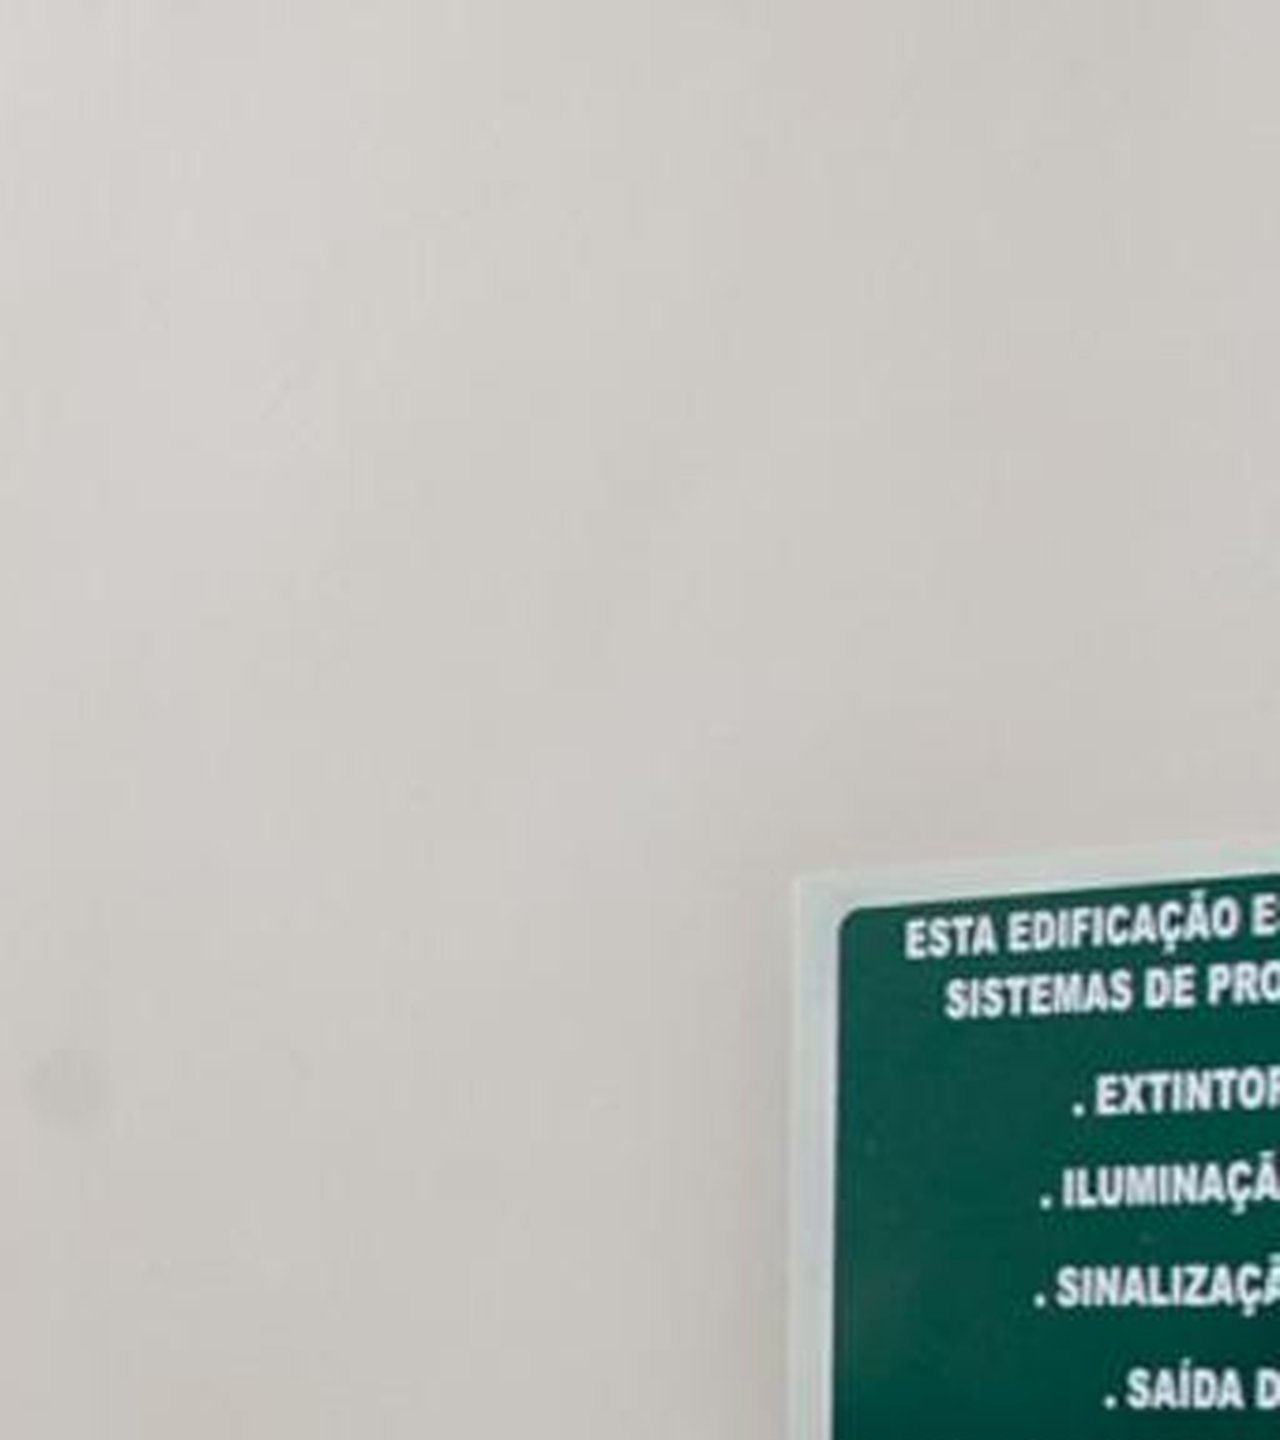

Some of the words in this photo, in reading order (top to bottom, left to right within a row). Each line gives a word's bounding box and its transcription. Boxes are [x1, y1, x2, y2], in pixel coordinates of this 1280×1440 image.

[904, 913, 998, 960] ESTA
[1007, 888, 1242, 954] EDIFICAÇÃO
[945, 968, 1134, 1020] SISTEMAS
[1144, 964, 1196, 1009] DE
[1207, 959, 1280, 1005] PRO
[1062, 1150, 1280, 1214] ILUMINAÇÃ
[1126, 1358, 1245, 1409] SAÍDA
